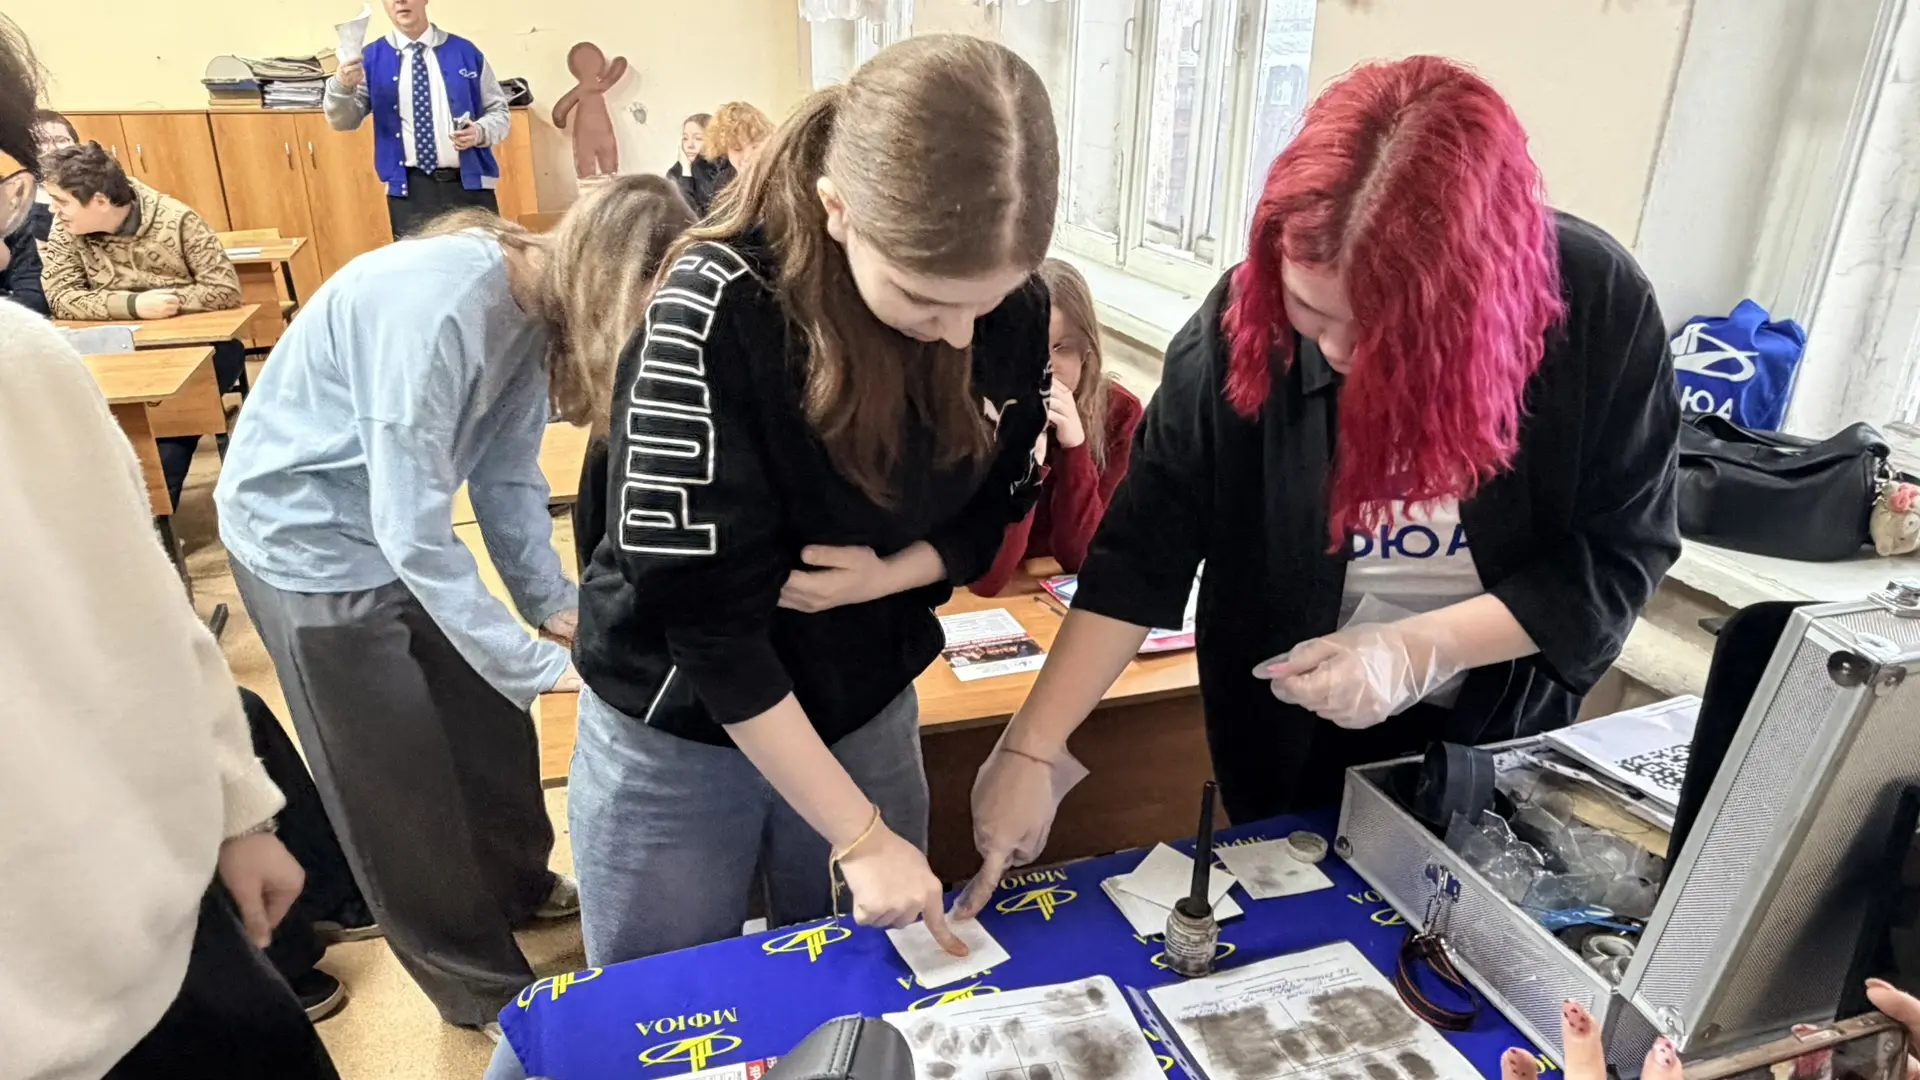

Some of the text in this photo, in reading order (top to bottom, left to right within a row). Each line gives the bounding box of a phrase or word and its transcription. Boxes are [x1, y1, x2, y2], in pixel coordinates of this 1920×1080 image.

[1680, 385, 1734, 421] ЮА
[1000, 866, 1069, 890] МФЮ
[633, 1006, 741, 1037] МФЮА
